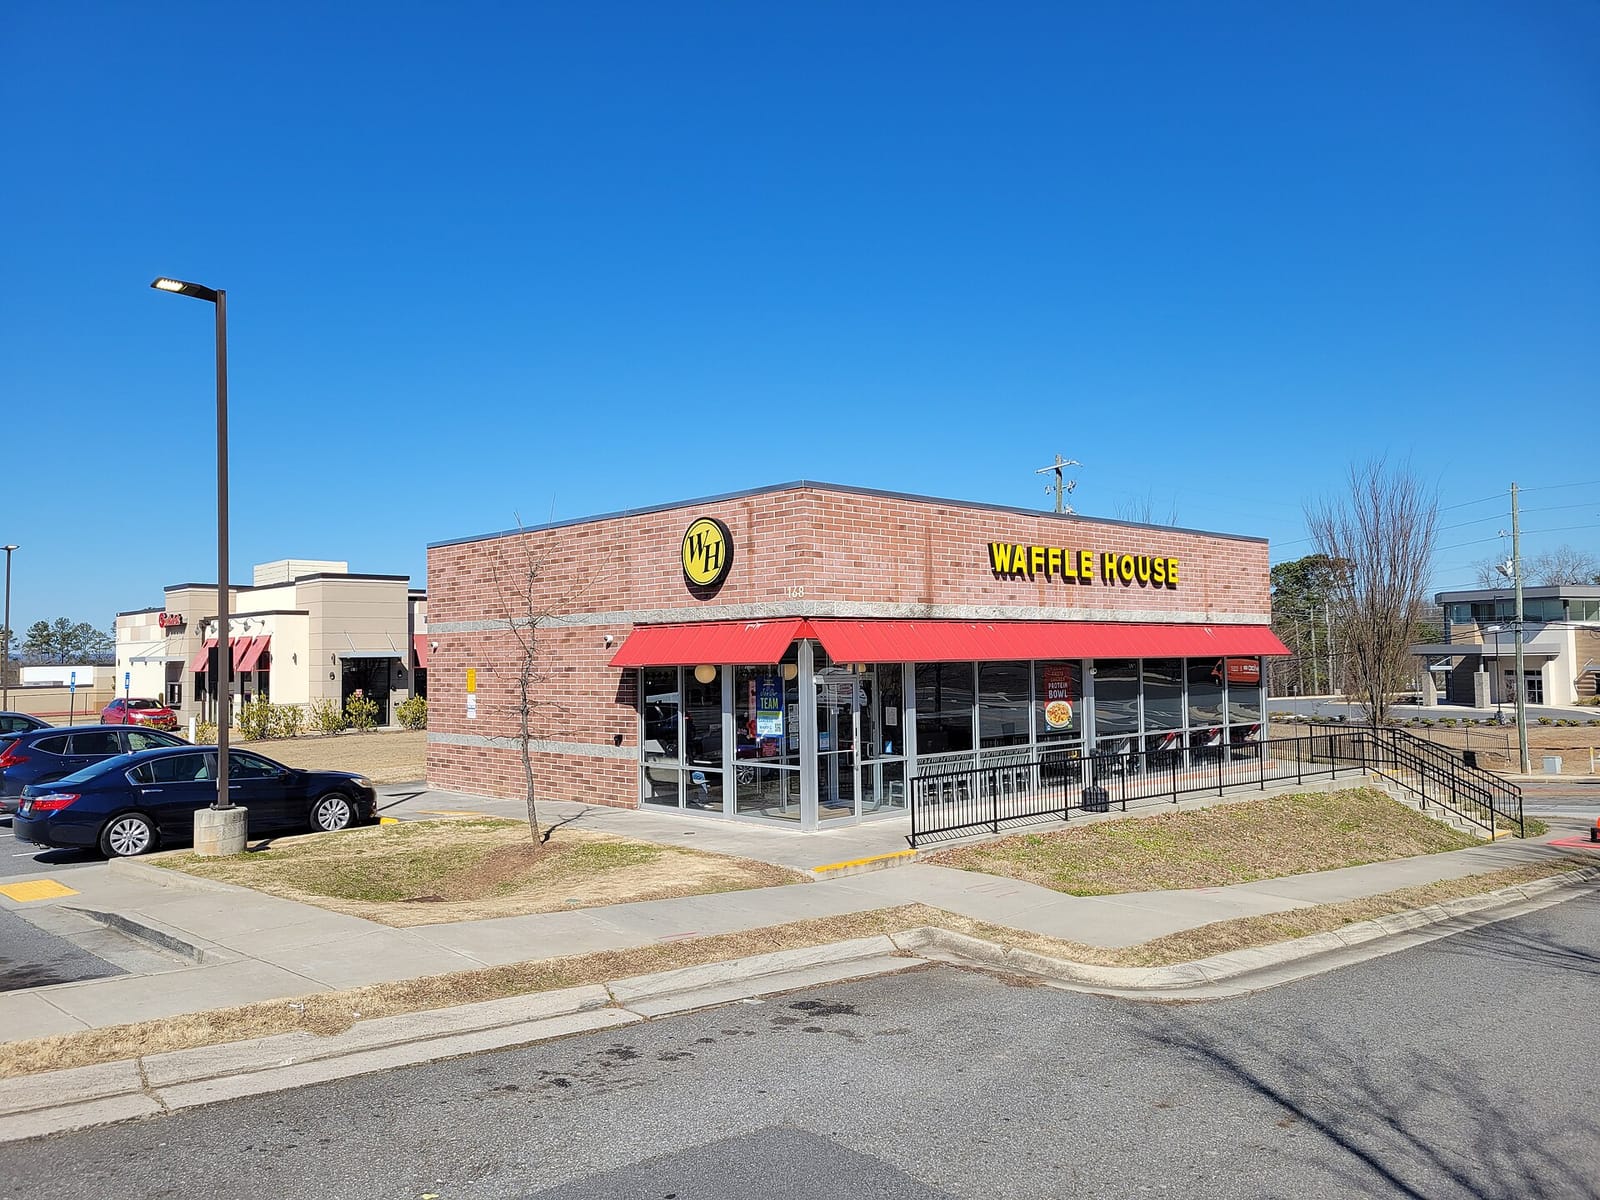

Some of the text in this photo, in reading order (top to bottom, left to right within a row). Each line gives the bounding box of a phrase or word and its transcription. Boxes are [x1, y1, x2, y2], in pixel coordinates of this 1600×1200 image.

[990, 542, 1179, 584] WAFFLE HOUSE
[787, 586, 805, 598] 168
[1048, 689, 1068, 699] BOWL
[760, 697, 779, 709] TEAM
